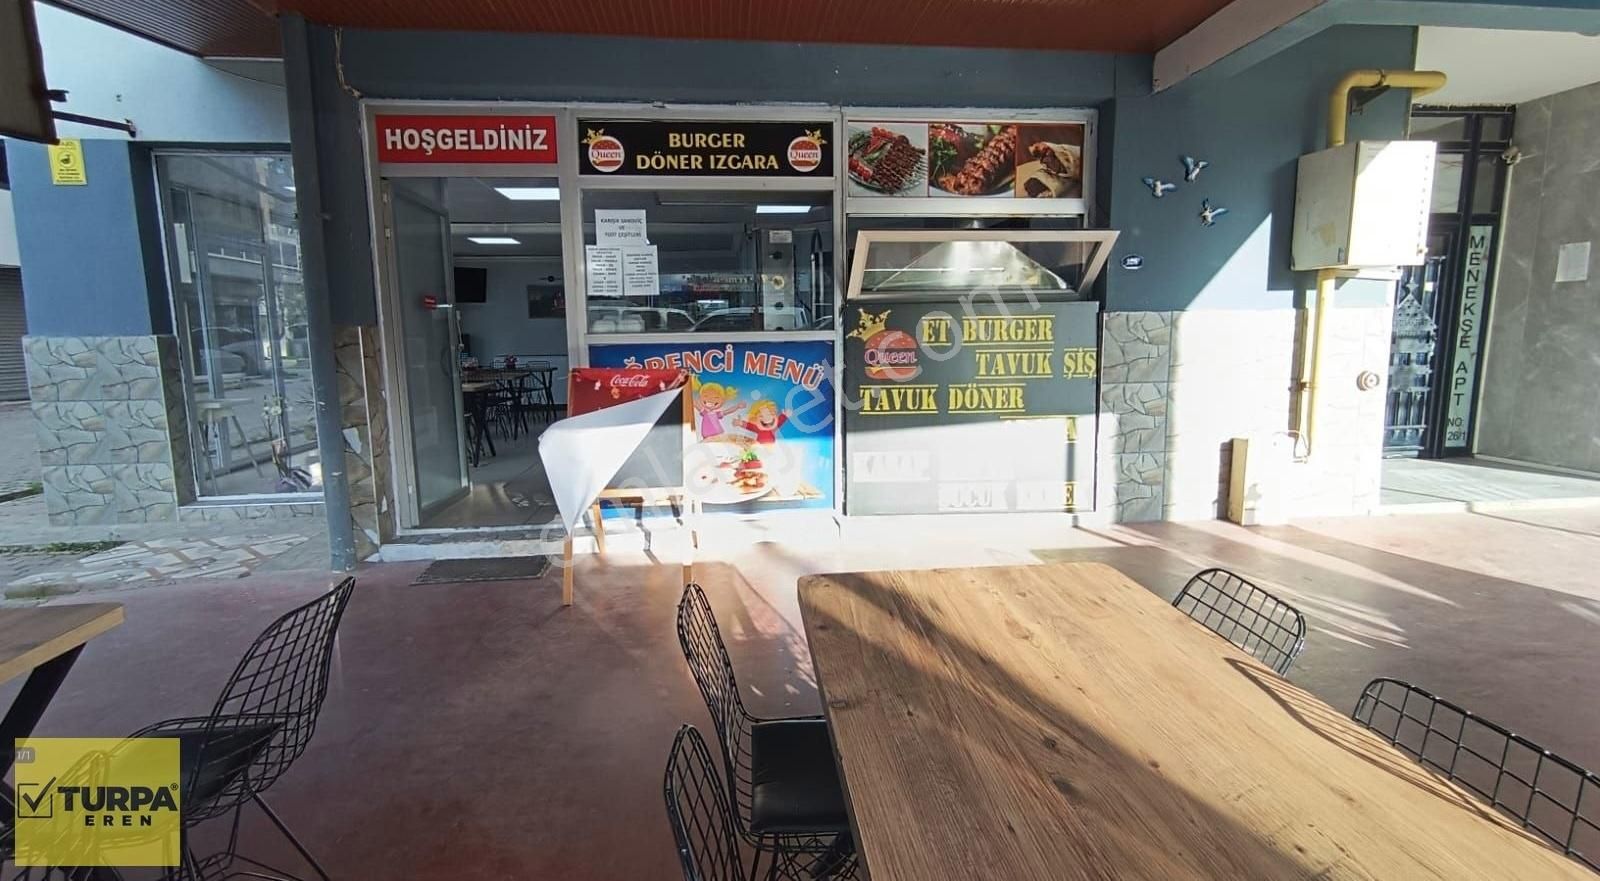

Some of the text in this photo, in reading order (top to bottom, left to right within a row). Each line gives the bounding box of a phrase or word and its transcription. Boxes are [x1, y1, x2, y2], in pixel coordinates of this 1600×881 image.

[385, 124, 548, 155] HOŞGELDİNİZ
[668, 132, 745, 149] BURGER
[591, 149, 621, 161] Queen
[636, 150, 780, 170] DÖNER IZGARA
[790, 149, 818, 161] Queen
[922, 318, 1054, 343] ET BURGER
[864, 348, 918, 366] Queen
[975, 347, 1097, 379] TAVUK ŞİŞ
[743, 350, 826, 392] MENÜ
[1453, 361, 1468, 407] APT
[859, 384, 1025, 412] TAVUK DÖNER
